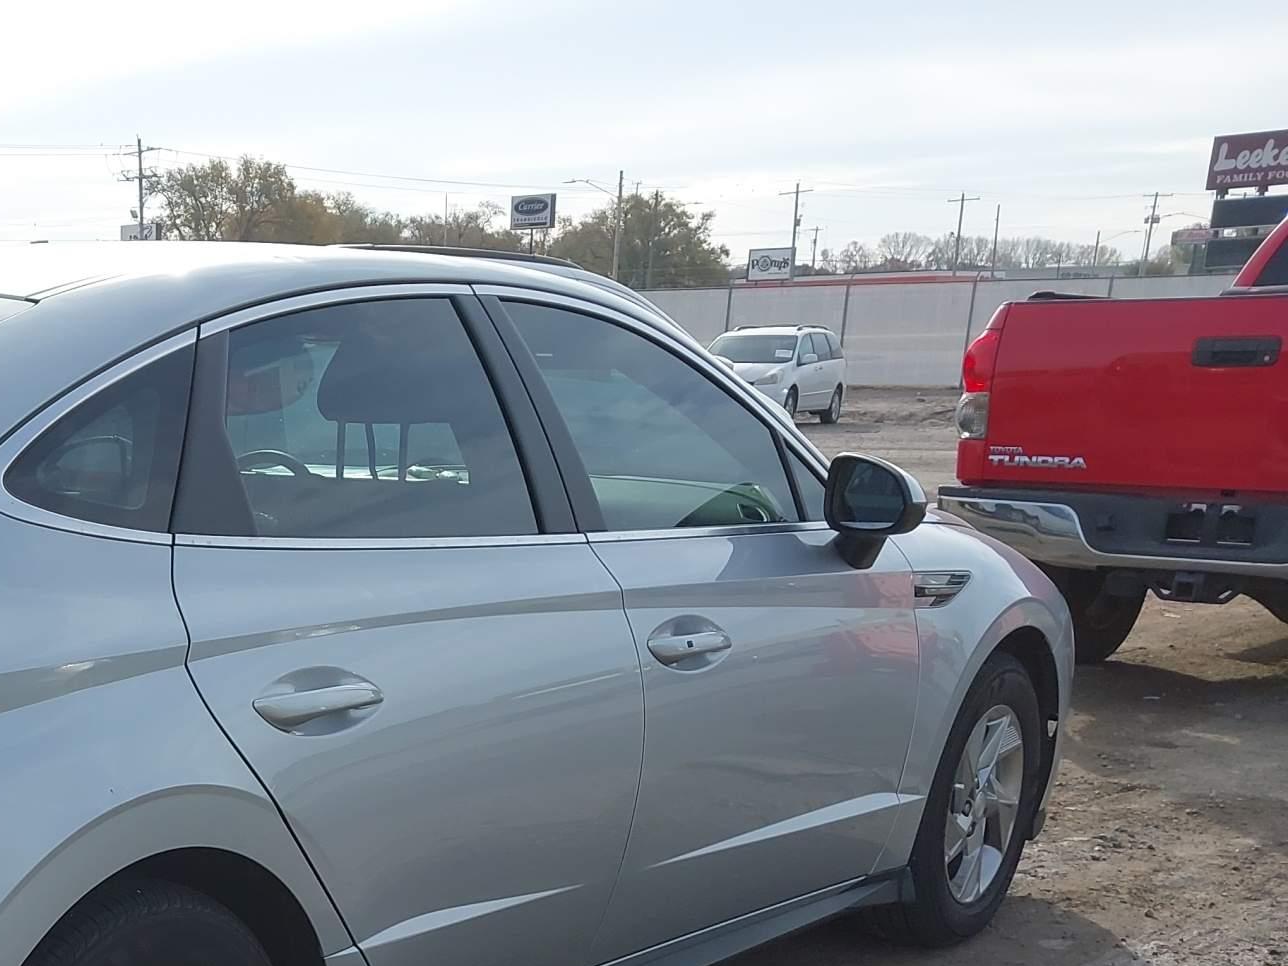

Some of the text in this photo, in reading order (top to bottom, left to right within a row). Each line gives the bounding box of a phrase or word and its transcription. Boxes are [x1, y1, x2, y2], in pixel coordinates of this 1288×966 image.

[1216, 172, 1264, 184] FAMILY
[988, 446, 1023, 454] TOYOTA
[988, 455, 1087, 469] TUNDRA
